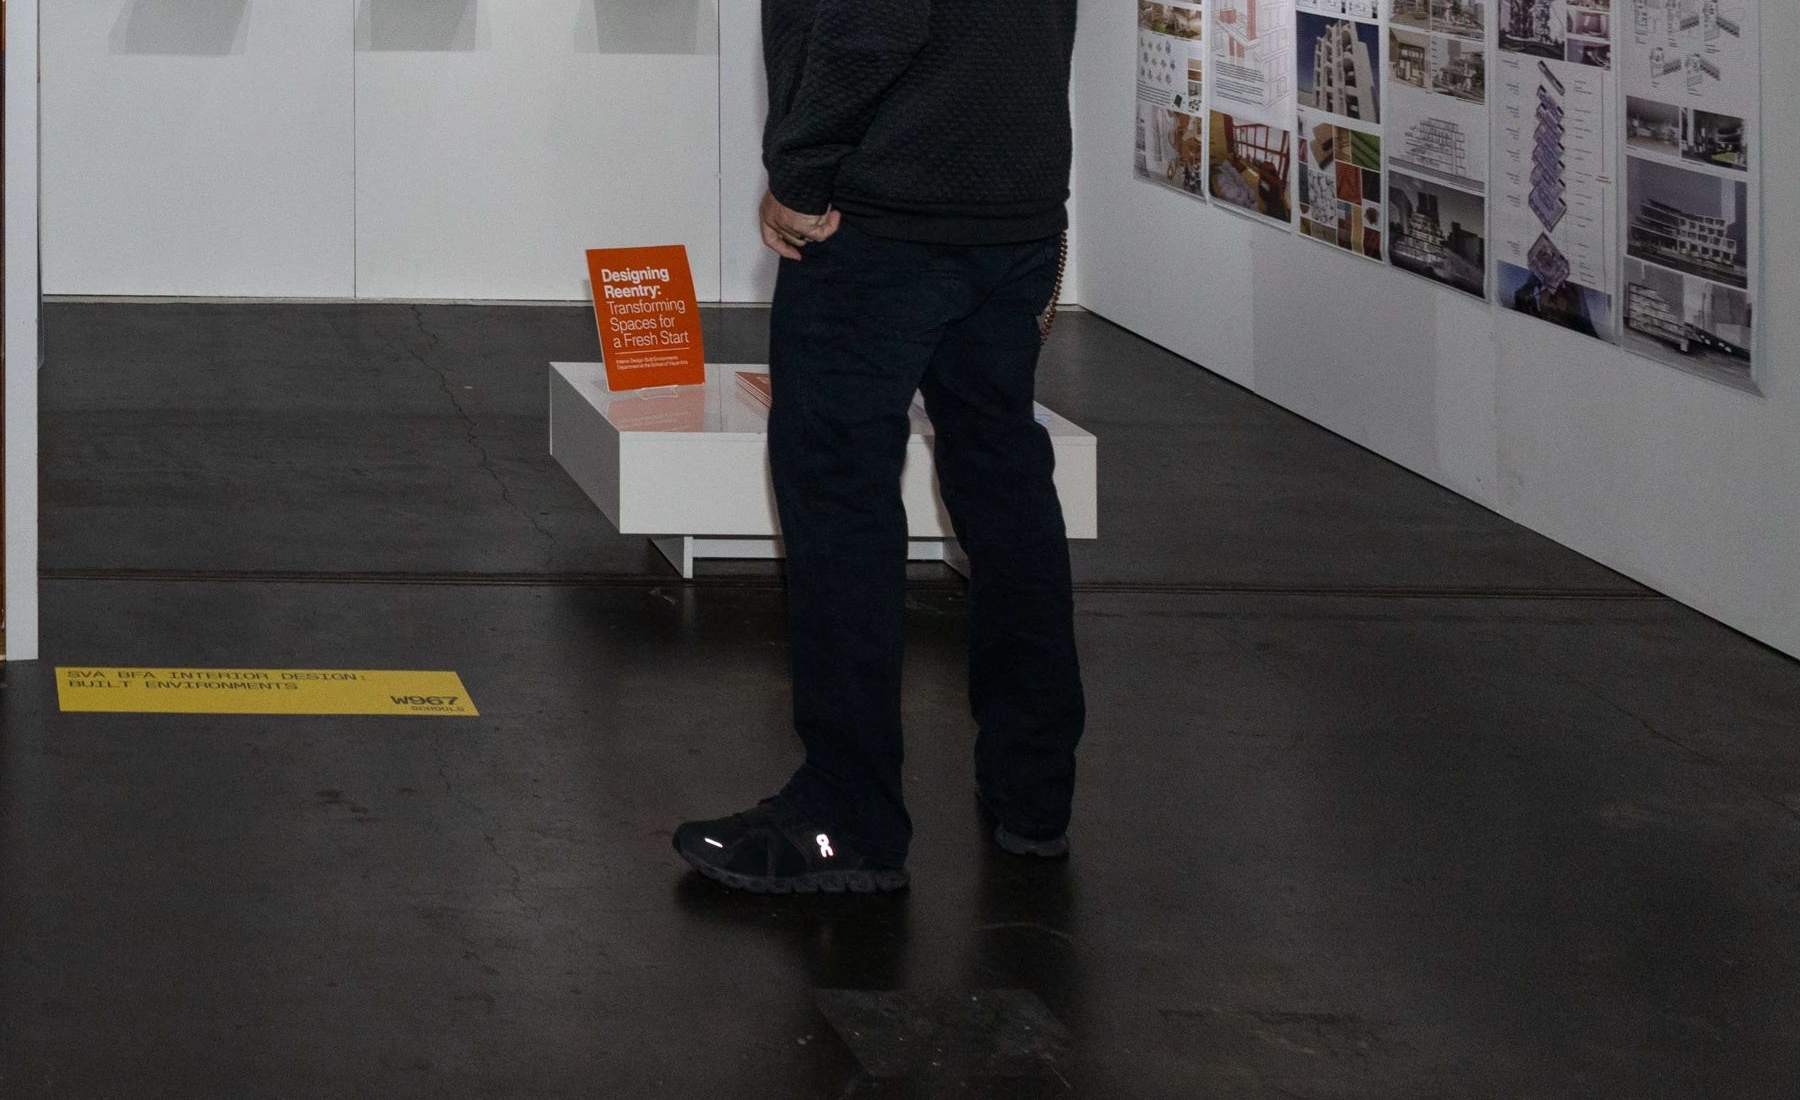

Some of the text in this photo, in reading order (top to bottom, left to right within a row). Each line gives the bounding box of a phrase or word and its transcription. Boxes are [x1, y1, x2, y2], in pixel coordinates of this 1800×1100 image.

[601, 266, 670, 284] Designing
[604, 284, 661, 299] Reentry:
[606, 299, 685, 315] Transforming
[609, 315, 675, 334] Spaces for
[613, 330, 690, 349] a Fresh Start
[170, 672, 269, 680] INTERIOR
[281, 672, 366, 681] DESIGN:
[68, 680, 298, 691] BUILT ENVIRONMENTS
[390, 695, 459, 706] W967
